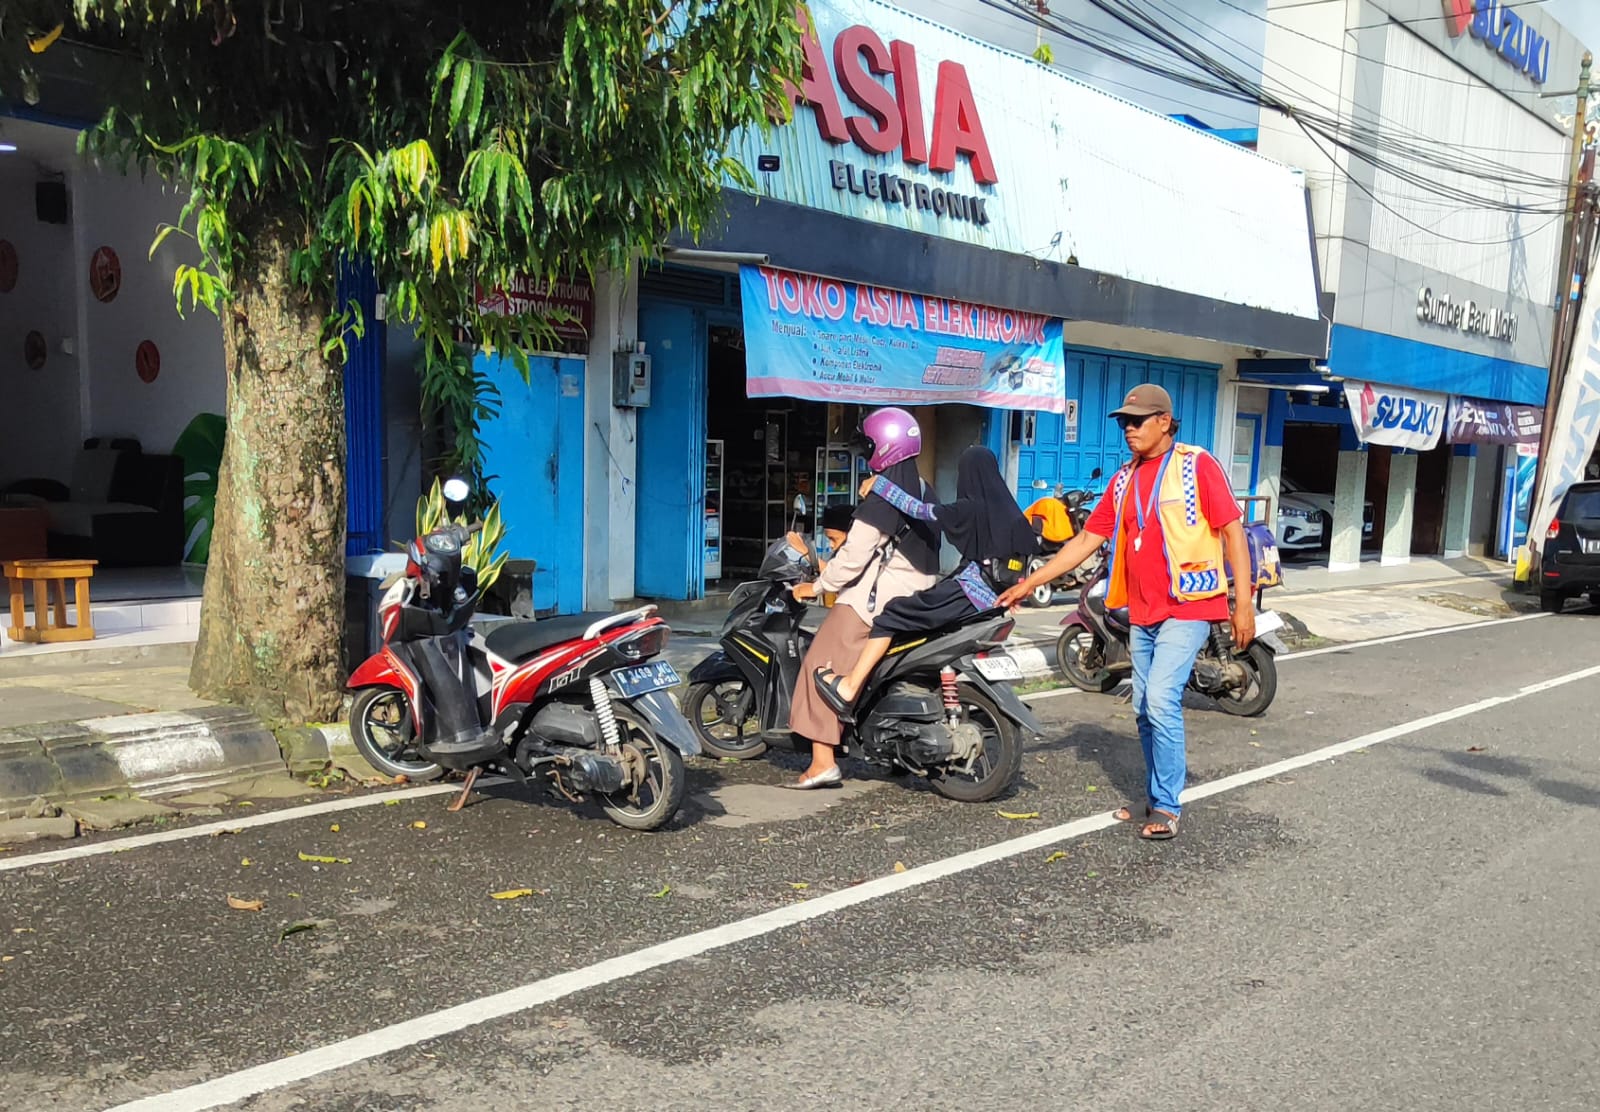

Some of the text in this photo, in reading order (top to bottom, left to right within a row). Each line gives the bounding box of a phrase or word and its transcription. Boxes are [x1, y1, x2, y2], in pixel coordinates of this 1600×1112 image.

[766, 0, 998, 185] ASIA
[829, 159, 990, 225] ELEKTRONIK
[760, 267, 846, 320] TOKO
[853, 284, 919, 330] ASIA
[1417, 288, 1518, 343] Sumber Baru Mobil
[772, 320, 806, 337] Menjual:
[1372, 395, 1438, 436] SUZUKI
